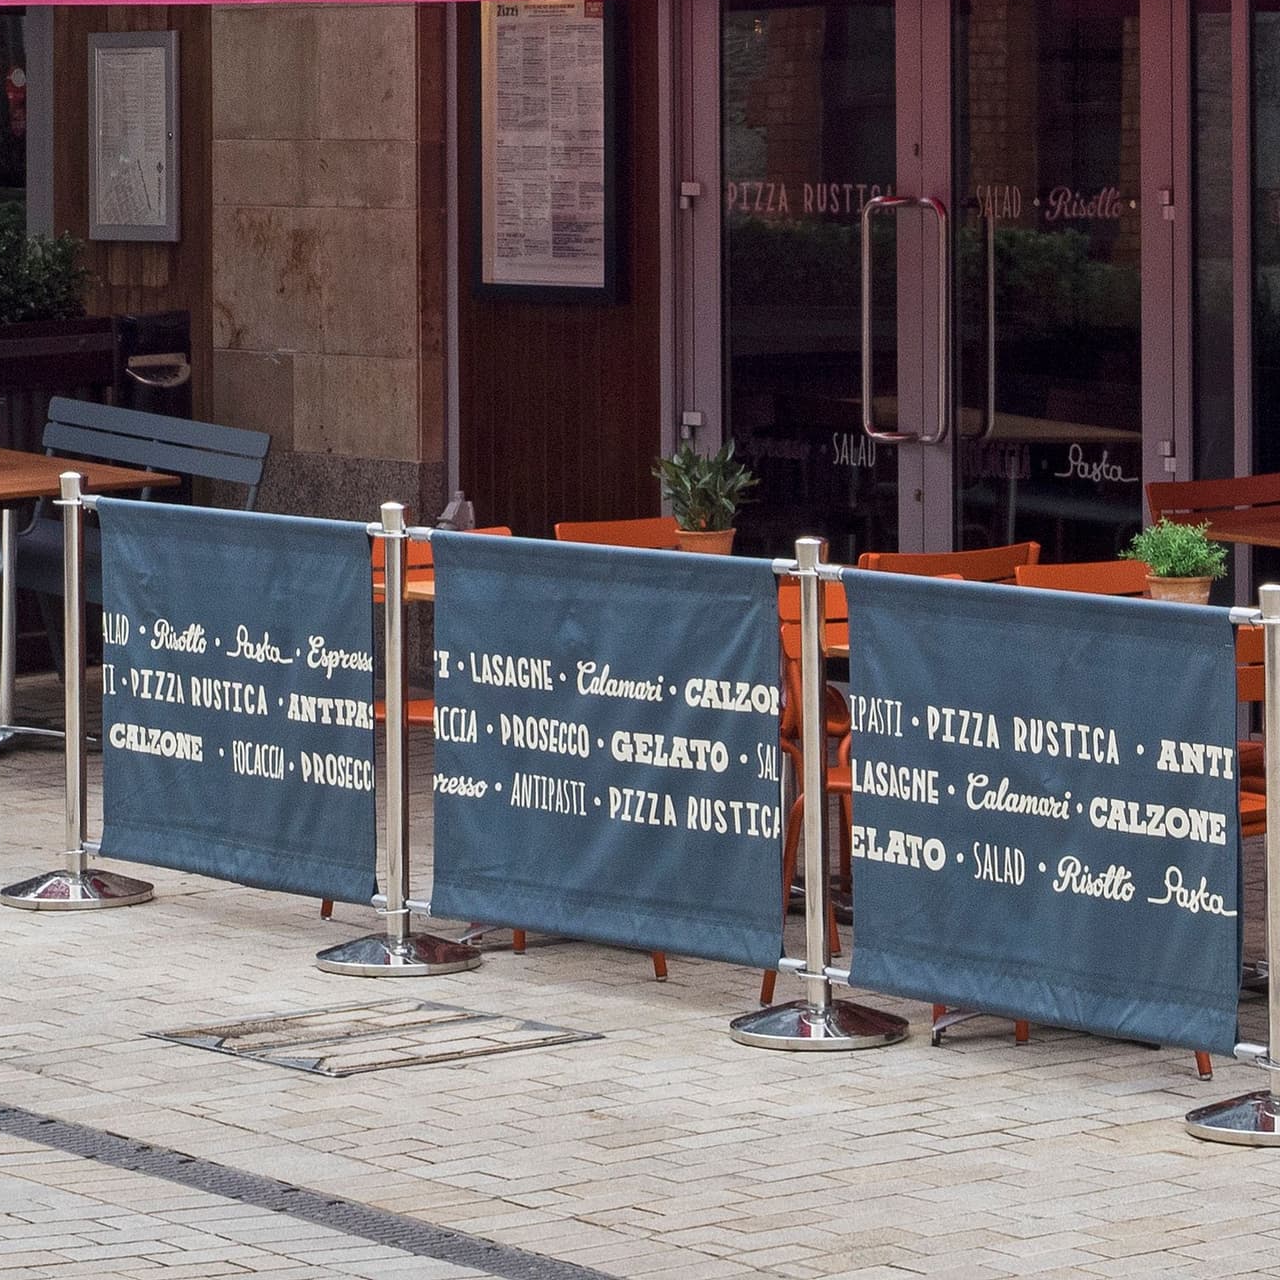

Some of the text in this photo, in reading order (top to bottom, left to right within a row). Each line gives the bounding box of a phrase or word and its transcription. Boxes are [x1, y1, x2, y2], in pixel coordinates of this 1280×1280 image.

[727, 181, 790, 214] PIZZA
[975, 185, 1021, 220] SALAD
[832, 431, 877, 469] SALAD
[1054, 442, 1139, 484] Pasta
[151, 619, 207, 654] Risotto
[227, 625, 293, 665] Pasta
[131, 668, 185, 705] PIZZA
[191, 676, 268, 716] RUSTICA
[470, 652, 553, 691] LASAGNE
[577, 660, 664, 702] Calamari
[109, 723, 375, 792] CALZONE FOCACCIA PROSECC
[500, 713, 589, 758] PROSECCO
[611, 730, 729, 772] GELATO
[927, 705, 1000, 750] PIZZA
[1014, 717, 1119, 765] RUSTICA
[1157, 739, 1234, 780] ANTI
[510, 772, 586, 816] ANTIPASTI
[609, 786, 677, 827] PIZZA
[852, 758, 1226, 845] LASAGNE Calamari CALZONE
[973, 841, 1026, 886] SALAD
[1053, 855, 1135, 902] Risotto
[1148, 865, 1238, 916] Pasta
